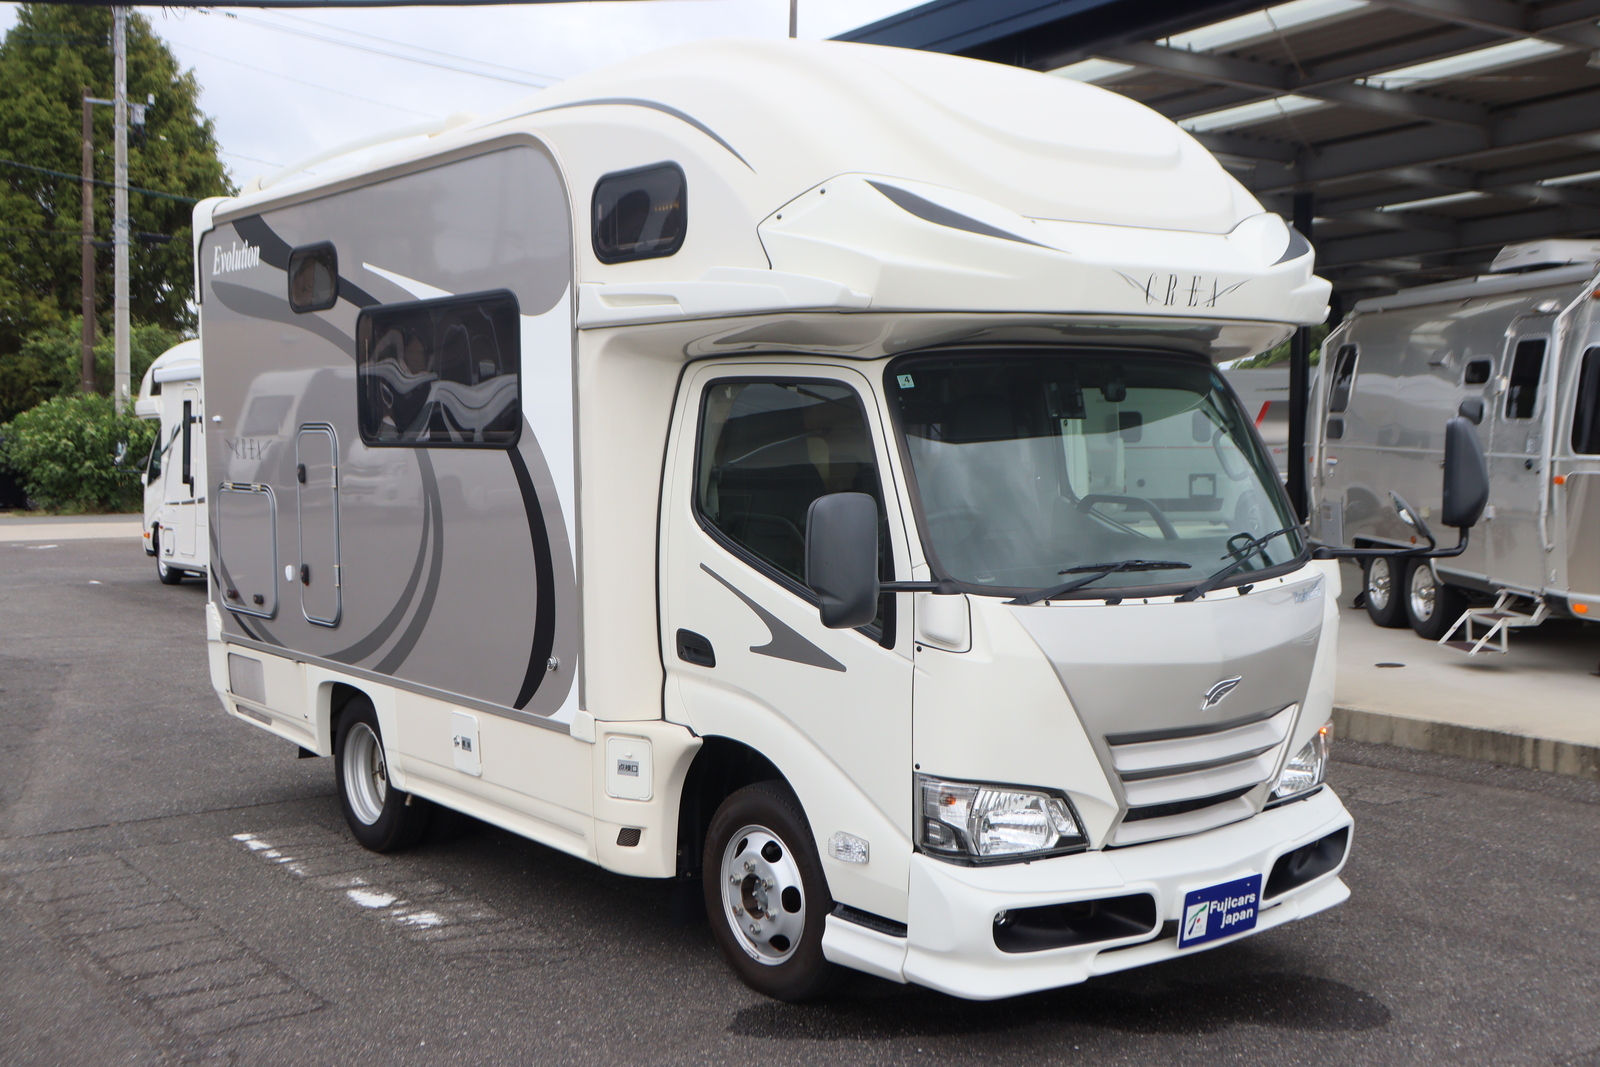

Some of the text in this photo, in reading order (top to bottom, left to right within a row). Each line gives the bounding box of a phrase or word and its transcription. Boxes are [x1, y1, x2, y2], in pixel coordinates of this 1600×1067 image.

[212, 239, 260, 276] Evolution
[1145, 272, 1218, 308] CREA
[1209, 893, 1256, 914] Fujicars
